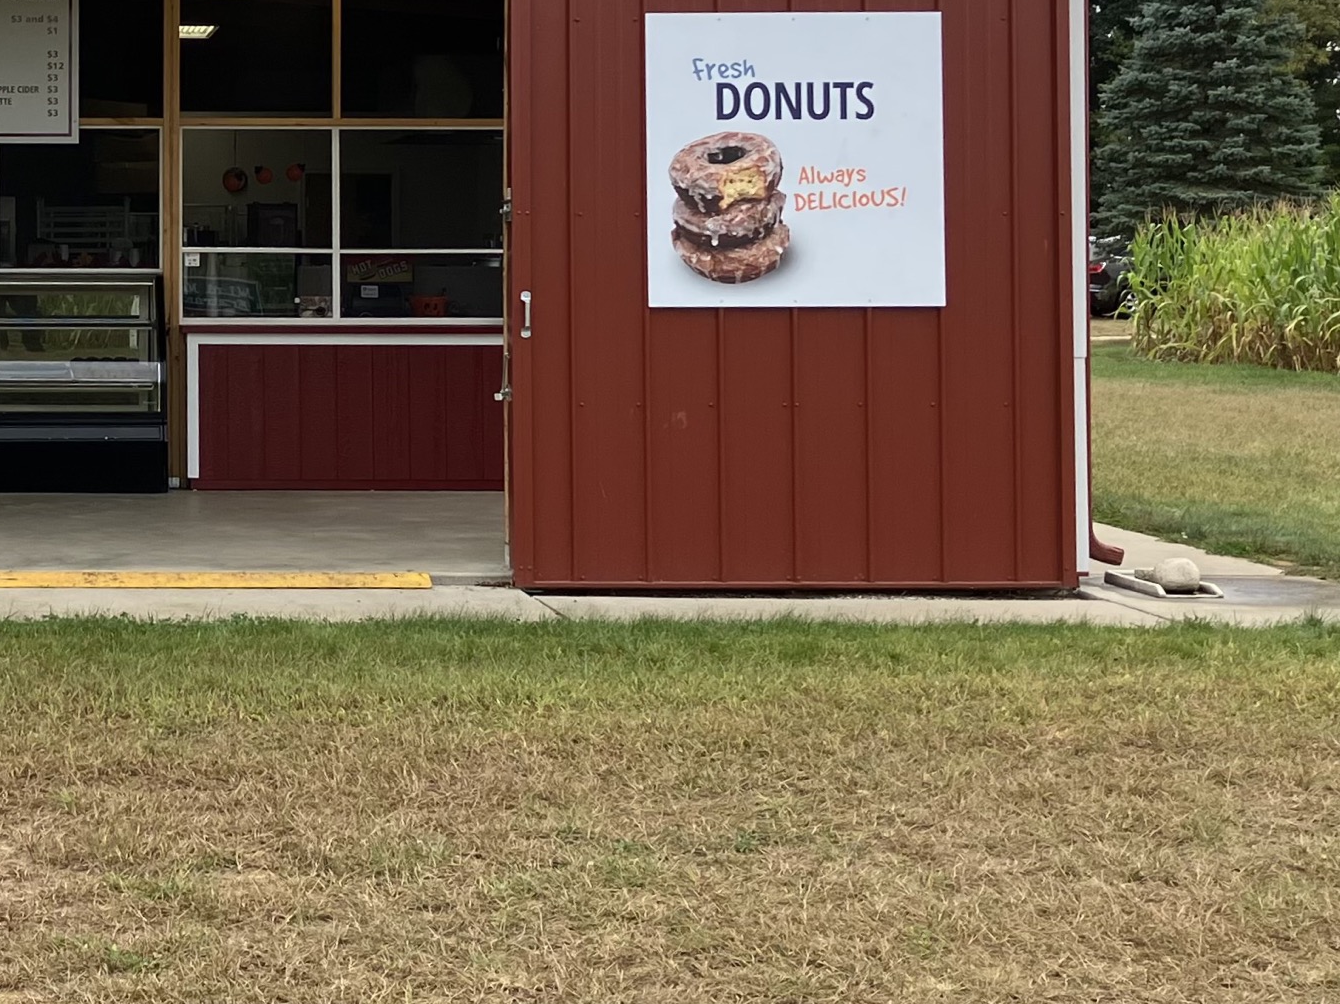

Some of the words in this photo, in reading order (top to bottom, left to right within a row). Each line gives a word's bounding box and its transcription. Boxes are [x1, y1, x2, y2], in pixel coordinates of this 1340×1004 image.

[11, 15, 22, 23] $3
[26, 15, 44, 23] and
[47, 27, 58, 35] $1
[47, 62, 64, 70] $12
[692, 57, 756, 81] Fresh
[47, 74, 58, 82] $3
[715, 81, 875, 120] DONUTS
[798, 166, 867, 187] Always
[793, 186, 908, 212] DELICIOUS!
[351, 259, 372, 274] HOT
[378, 260, 408, 278] DOGS
